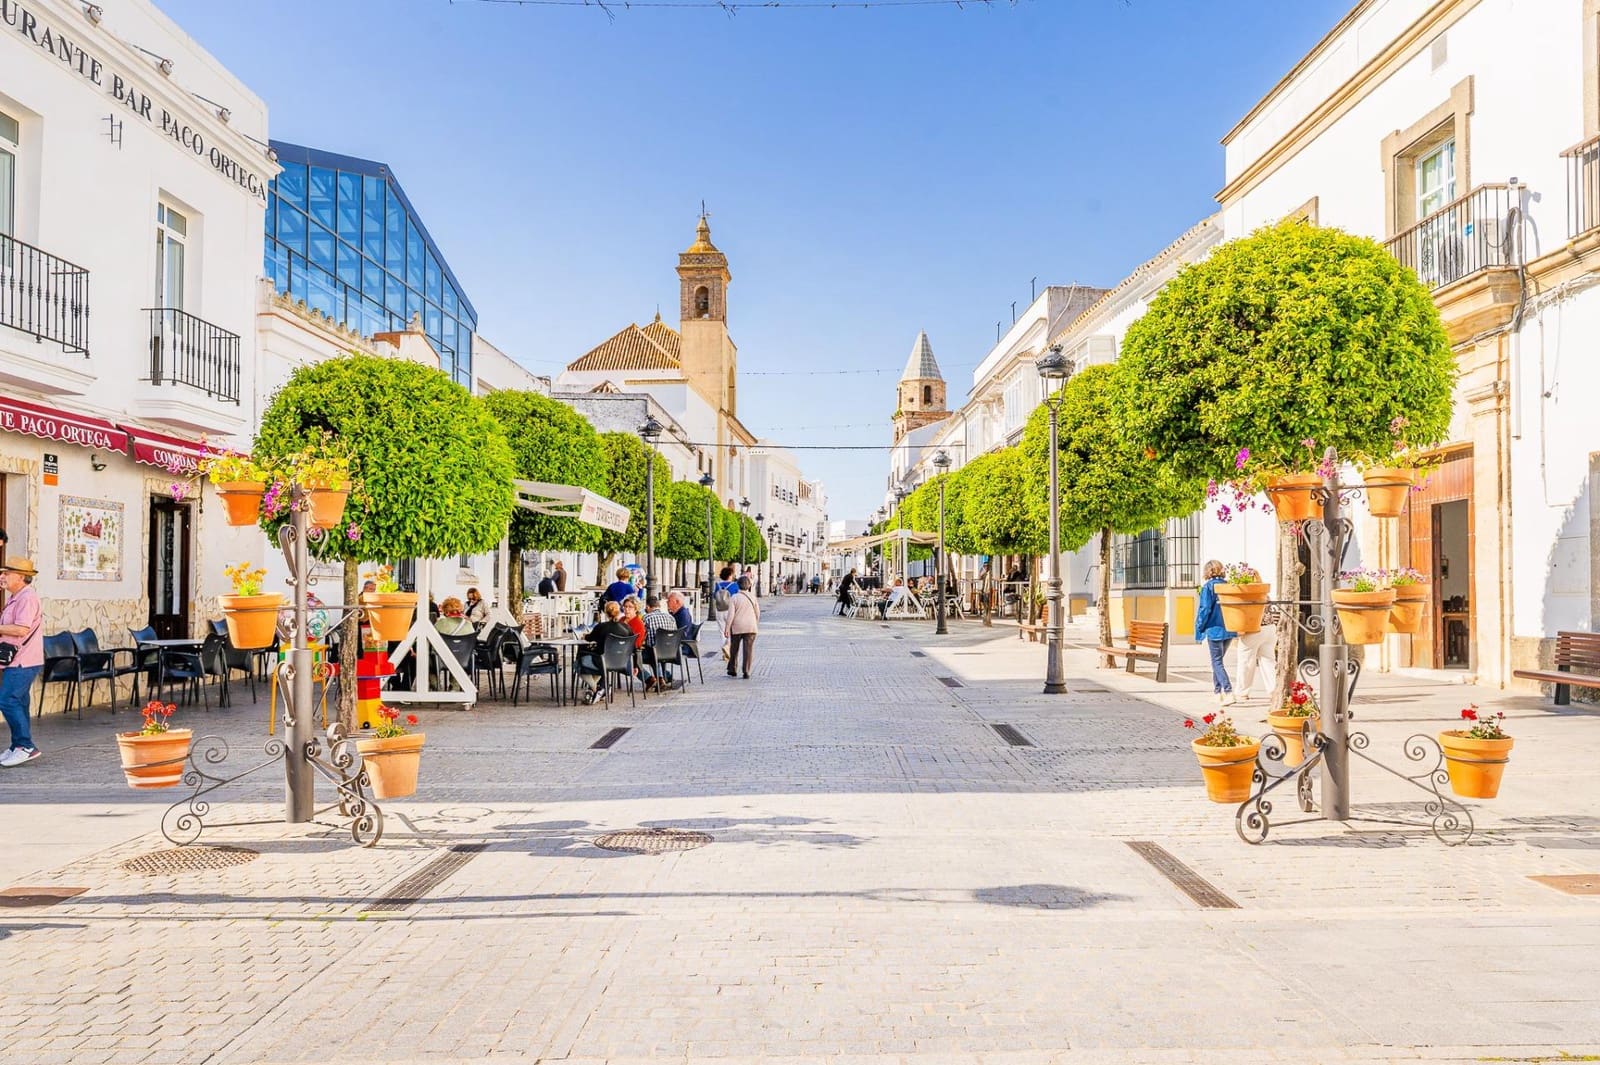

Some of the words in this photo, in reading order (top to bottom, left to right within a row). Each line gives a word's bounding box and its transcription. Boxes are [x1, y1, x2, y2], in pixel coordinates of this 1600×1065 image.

[112, 73, 152, 122] BAR
[161, 108, 204, 156] PACO
[209, 147, 266, 201] ORTEGA
[20, 414, 56, 436] PACO
[61, 424, 112, 447] ORTEGA
